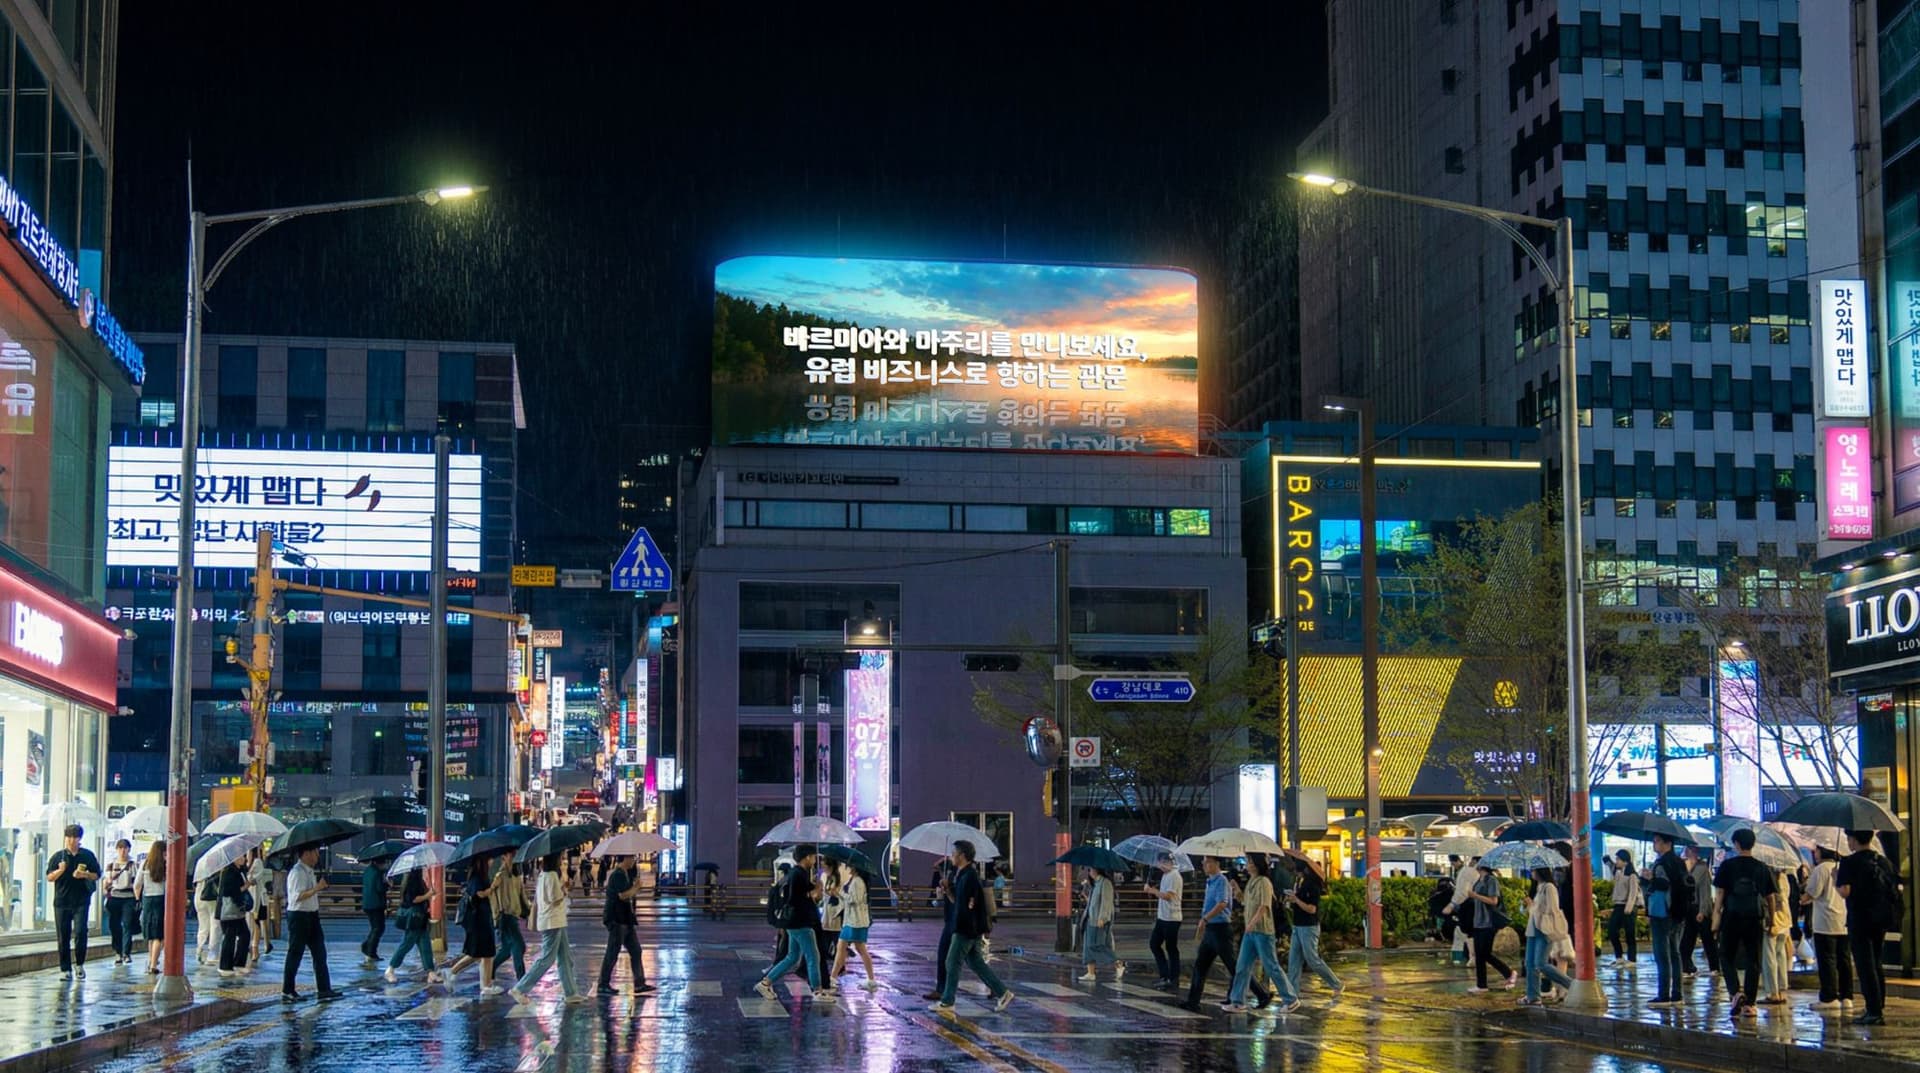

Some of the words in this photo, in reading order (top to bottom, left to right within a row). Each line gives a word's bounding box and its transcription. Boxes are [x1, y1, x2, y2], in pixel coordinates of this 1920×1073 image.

[1834, 288, 1854, 345] 맛있게
[783, 325, 910, 355] 바르미아와
[915, 328, 1013, 358] 마주리를
[1020, 332, 1149, 362] 만나보세요,
[804, 357, 857, 385] 유럽
[863, 358, 990, 387] 비즈니스로
[996, 361, 1072, 389] 향하는
[1078, 364, 1128, 391] 관문
[1836, 348, 1857, 386] 맵다
[262, 476, 327, 506] 맵다
[113, 518, 170, 542] 최고,
[1846, 586, 1920, 645] LLO
[1174, 686, 1190, 695] 410
[855, 722, 881, 741] 07
[854, 741, 883, 760] 47
[1452, 805, 1490, 814] LLOYD
